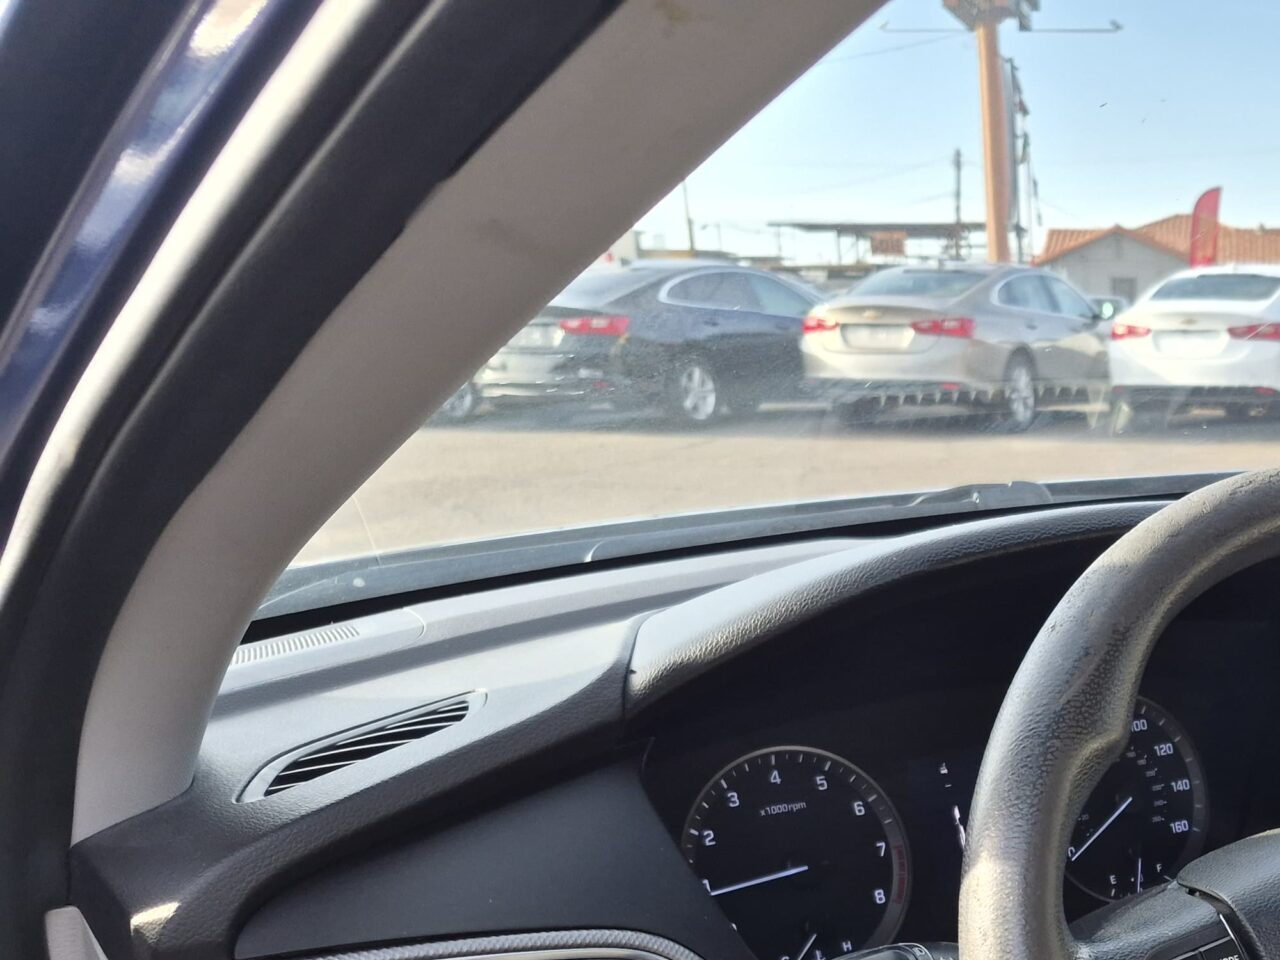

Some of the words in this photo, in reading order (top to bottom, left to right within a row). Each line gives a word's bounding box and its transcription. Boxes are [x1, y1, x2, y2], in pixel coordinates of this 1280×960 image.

[1154, 743, 1174, 757] 120
[770, 769, 782, 785] 4
[816, 775, 828, 791] 5
[1170, 779, 1190, 793] 140
[727, 792, 740, 808] 3
[854, 801, 866, 816] 6
[1170, 820, 1190, 835] 160
[703, 830, 716, 846] 2
[876, 842, 886, 857] 7
[1110, 875, 1118, 885] E
[874, 889, 886, 904] 8
